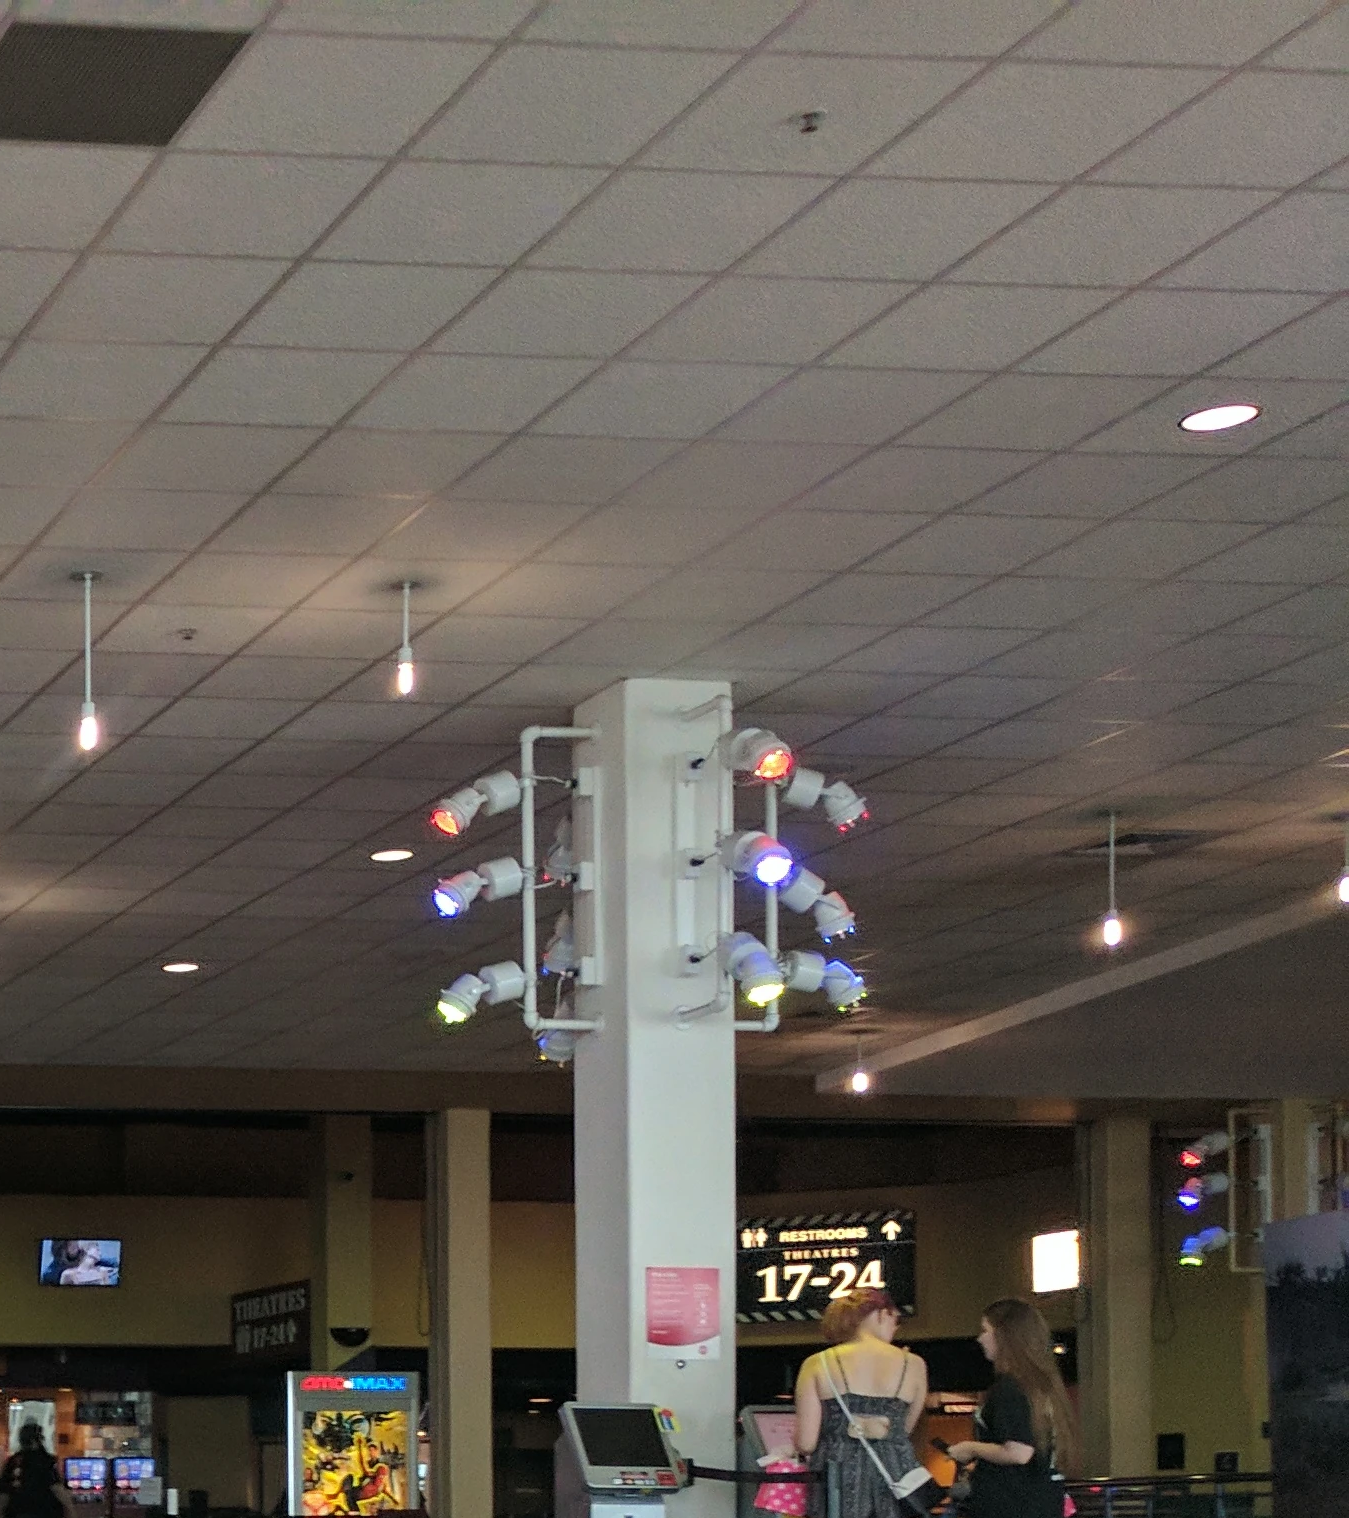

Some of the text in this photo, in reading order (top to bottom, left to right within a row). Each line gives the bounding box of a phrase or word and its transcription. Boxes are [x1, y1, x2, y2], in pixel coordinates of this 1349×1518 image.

[779, 1227, 869, 1243] RESTROOMS
[782, 1247, 860, 1261] THEATRES
[755, 1259, 887, 1303] 17-24
[349, 1375, 408, 1392] IMAX
